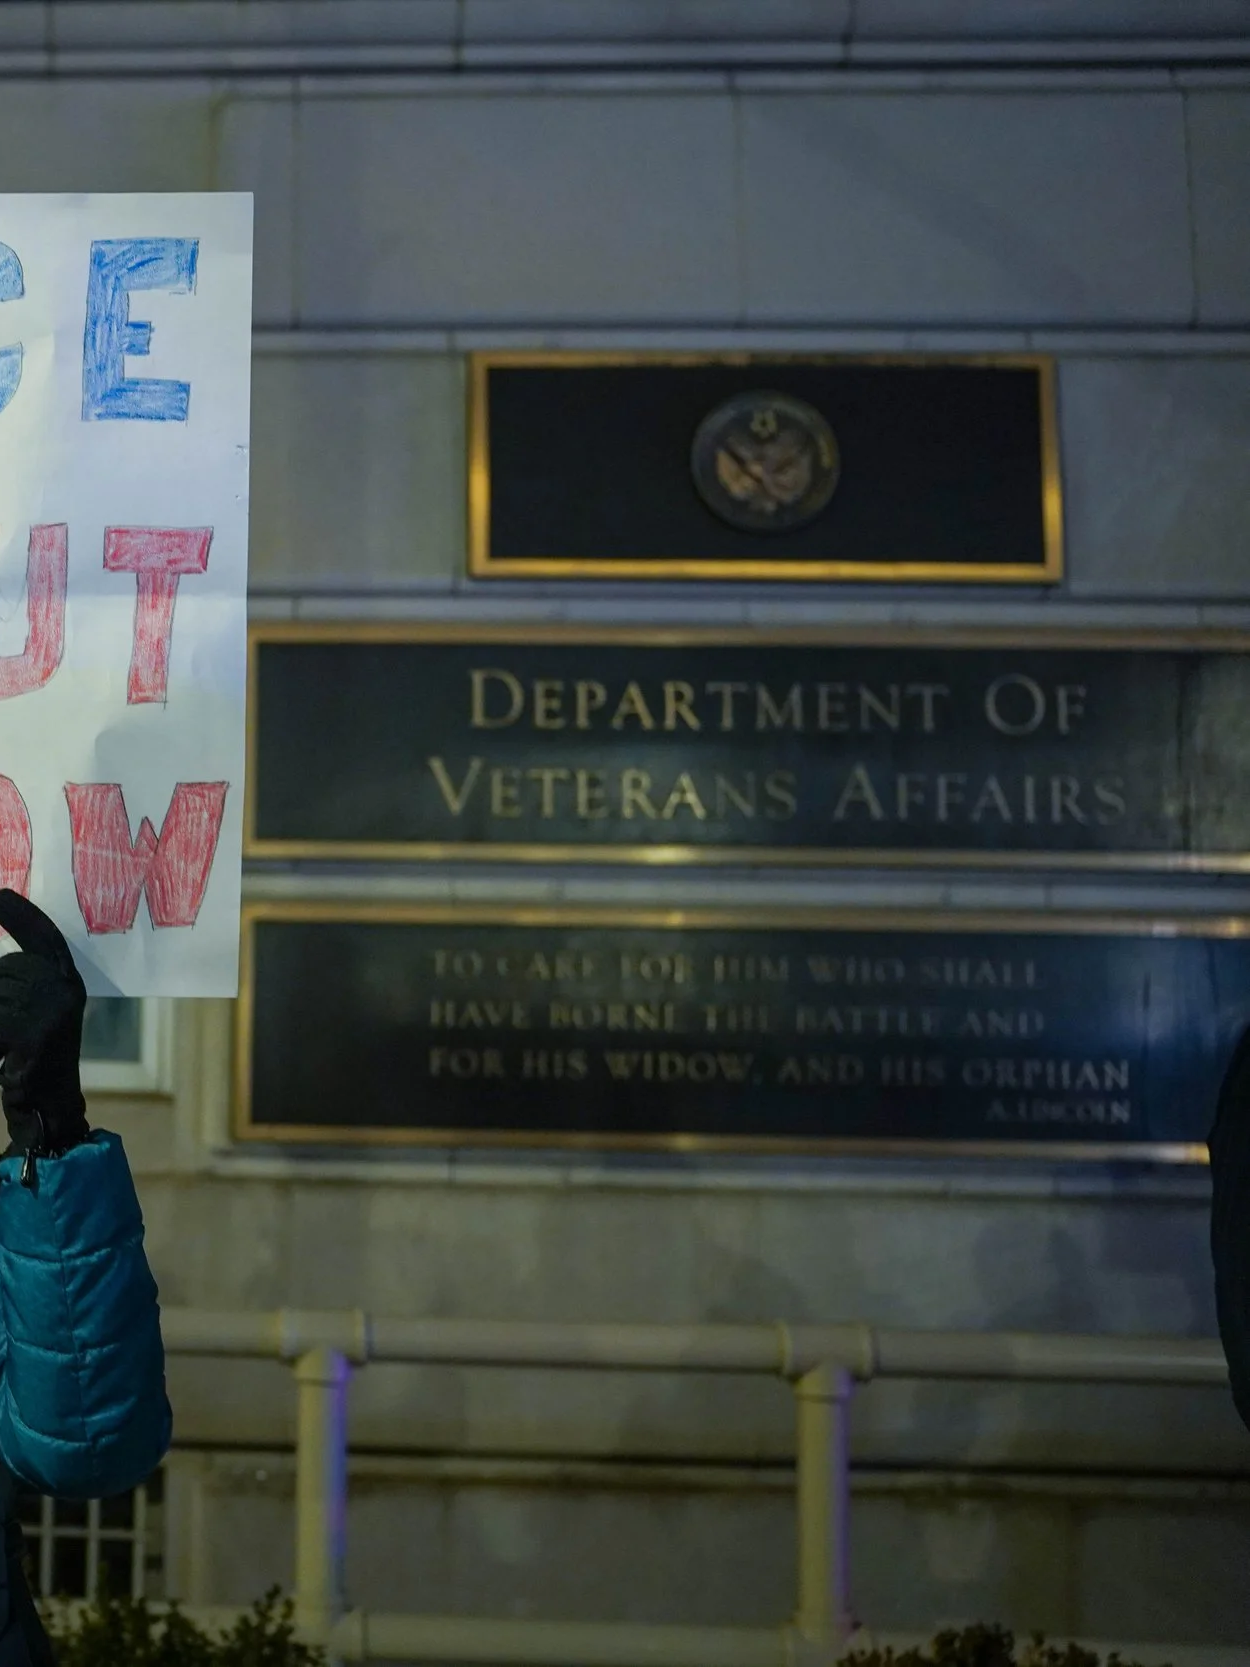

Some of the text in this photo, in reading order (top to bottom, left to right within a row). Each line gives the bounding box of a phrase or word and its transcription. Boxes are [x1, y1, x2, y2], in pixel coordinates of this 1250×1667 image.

[468, 668, 951, 733] DEPARTMENT
[428, 756, 1126, 826] VETERANS AFFAIRS
[433, 950, 483, 979] TO
[430, 999, 530, 1030] HAVE
[960, 1008, 1045, 1037] AND
[430, 1047, 505, 1079] FOR
[523, 1049, 588, 1081] HIS
[778, 1055, 865, 1087] AND
[881, 1057, 946, 1088] HIS
[962, 1058, 1131, 1091] ORPHAN
